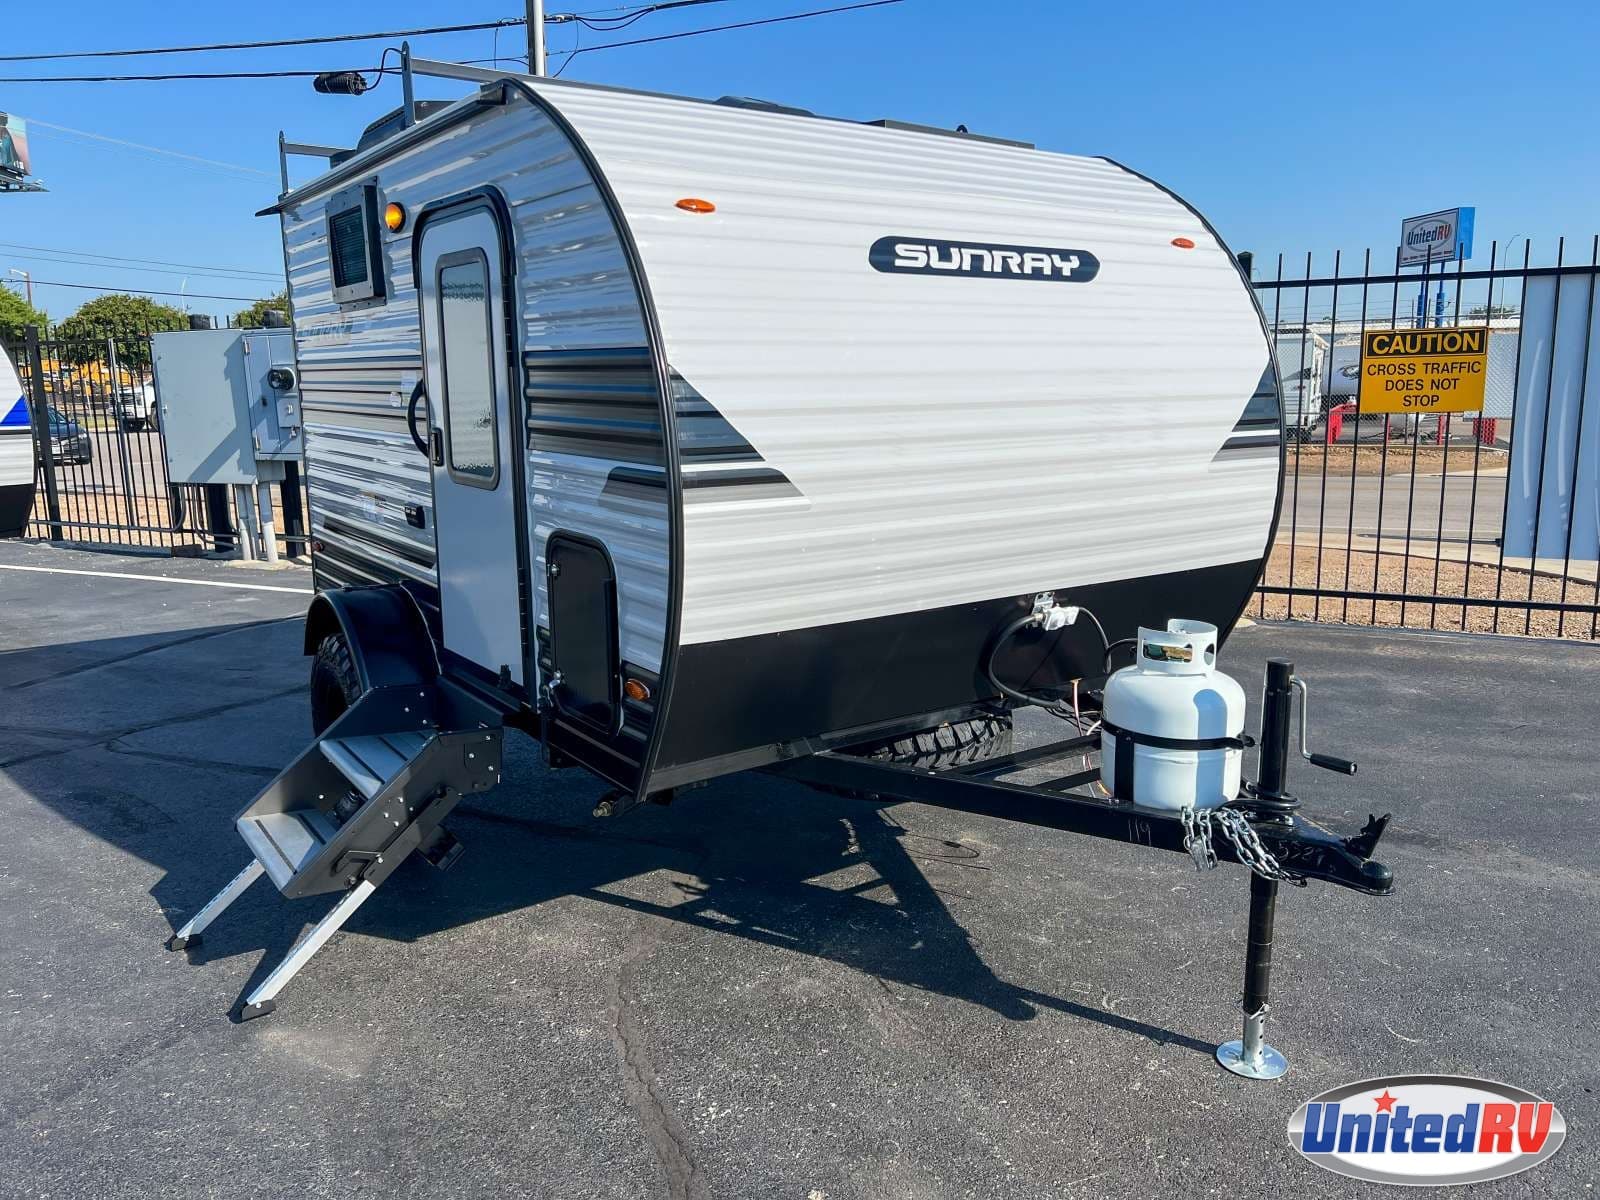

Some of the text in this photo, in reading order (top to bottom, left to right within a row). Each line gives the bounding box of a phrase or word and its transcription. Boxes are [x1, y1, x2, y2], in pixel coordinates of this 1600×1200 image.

[894, 243, 1080, 276] SUNRAY
[1372, 331, 1480, 355] CAUTION
[1367, 361, 1482, 376] CROSS TRAFFIC
[1385, 378, 1460, 392] DOES NOT
[1402, 395, 1440, 407] STOP
